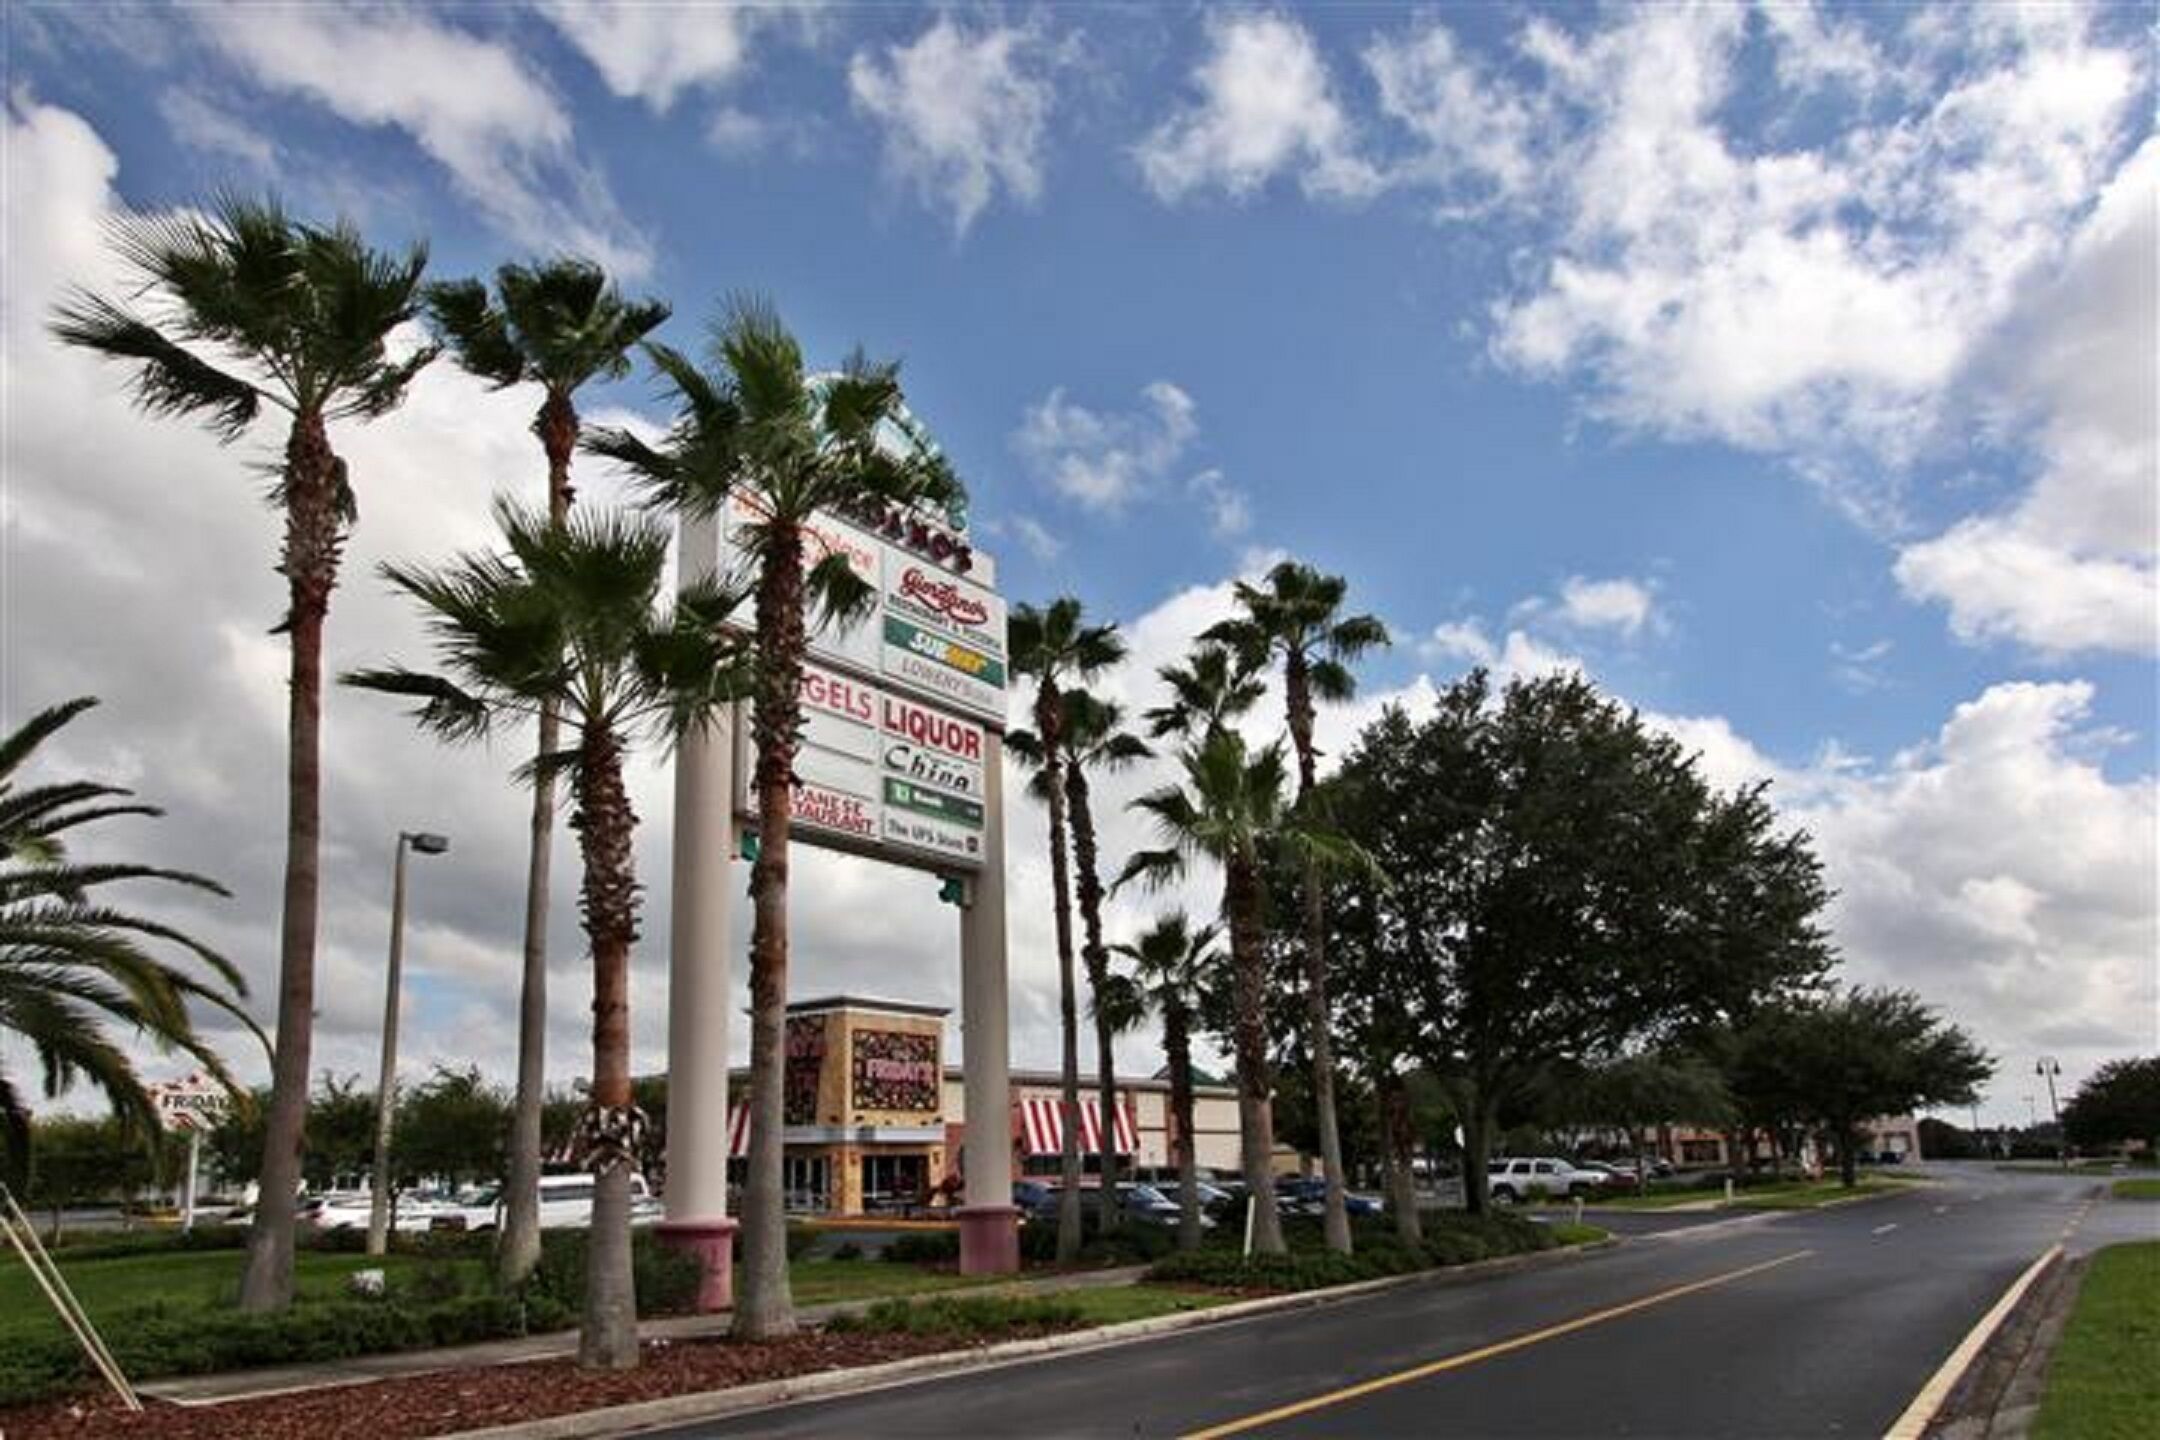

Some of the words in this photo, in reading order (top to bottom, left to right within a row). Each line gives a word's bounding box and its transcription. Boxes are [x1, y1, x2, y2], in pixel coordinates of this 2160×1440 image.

[908, 631, 988, 674] SUBWAY
[803, 673, 872, 720] GELS
[883, 698, 981, 759] LIQUOR
[884, 745, 970, 792] China
[887, 817, 909, 836] The
[911, 824, 934, 844] UPS
[936, 831, 965, 852] Store
